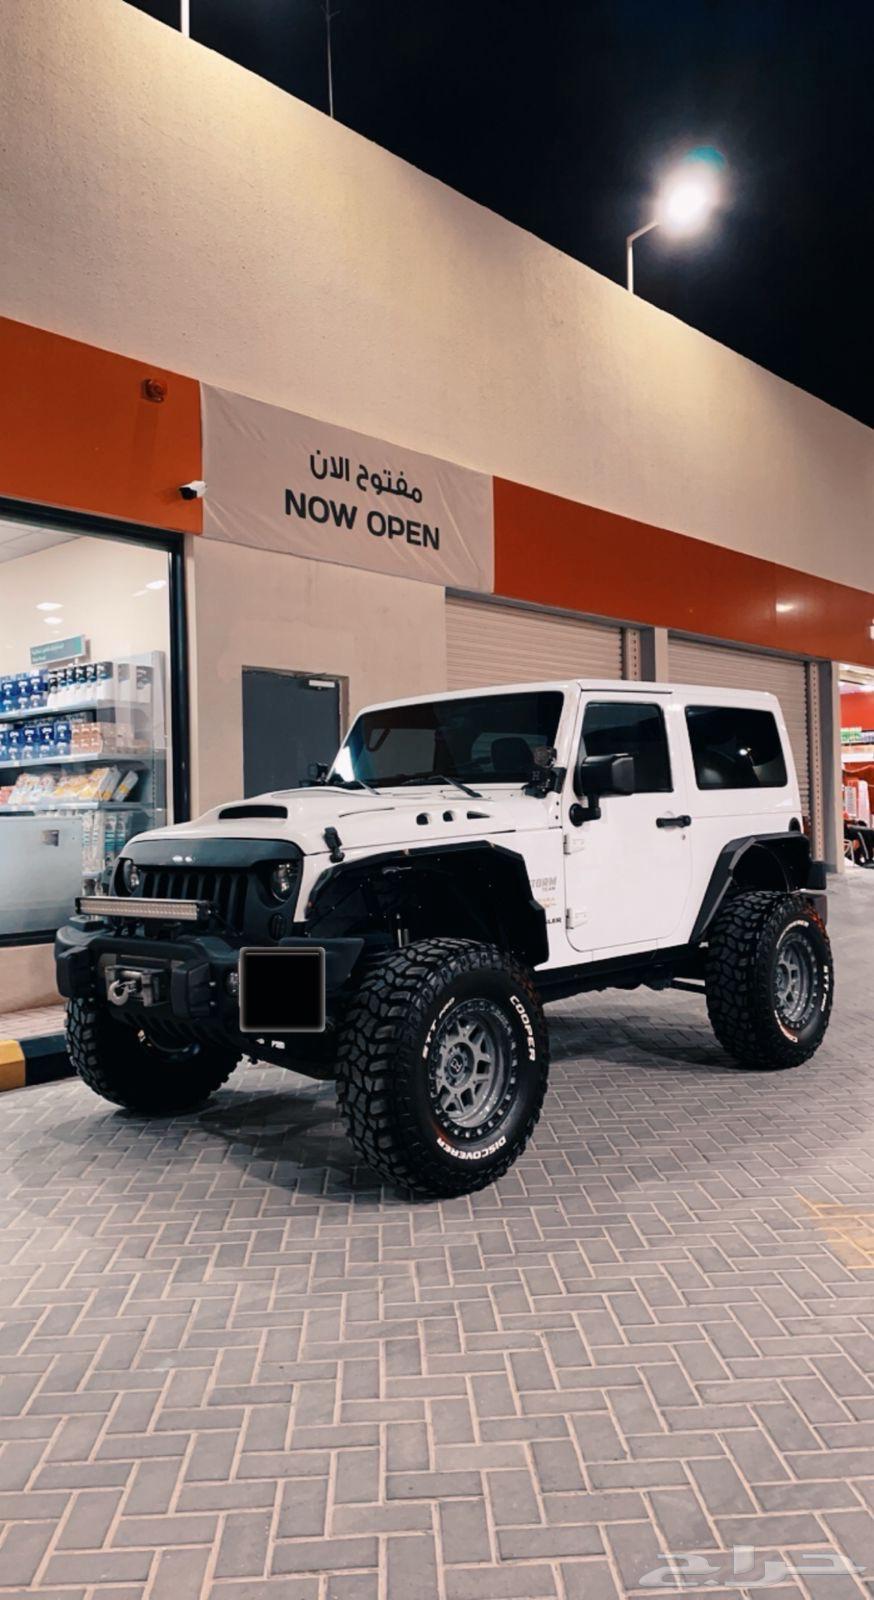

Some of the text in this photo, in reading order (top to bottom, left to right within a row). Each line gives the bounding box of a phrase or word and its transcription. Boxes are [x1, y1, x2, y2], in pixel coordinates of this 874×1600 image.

[356, 464, 423, 504] مفتوح
[284, 488, 440, 551] NOW OPEN
[509, 995, 536, 1061] COOPER
[436, 1135, 507, 1160] DISCOVERER
